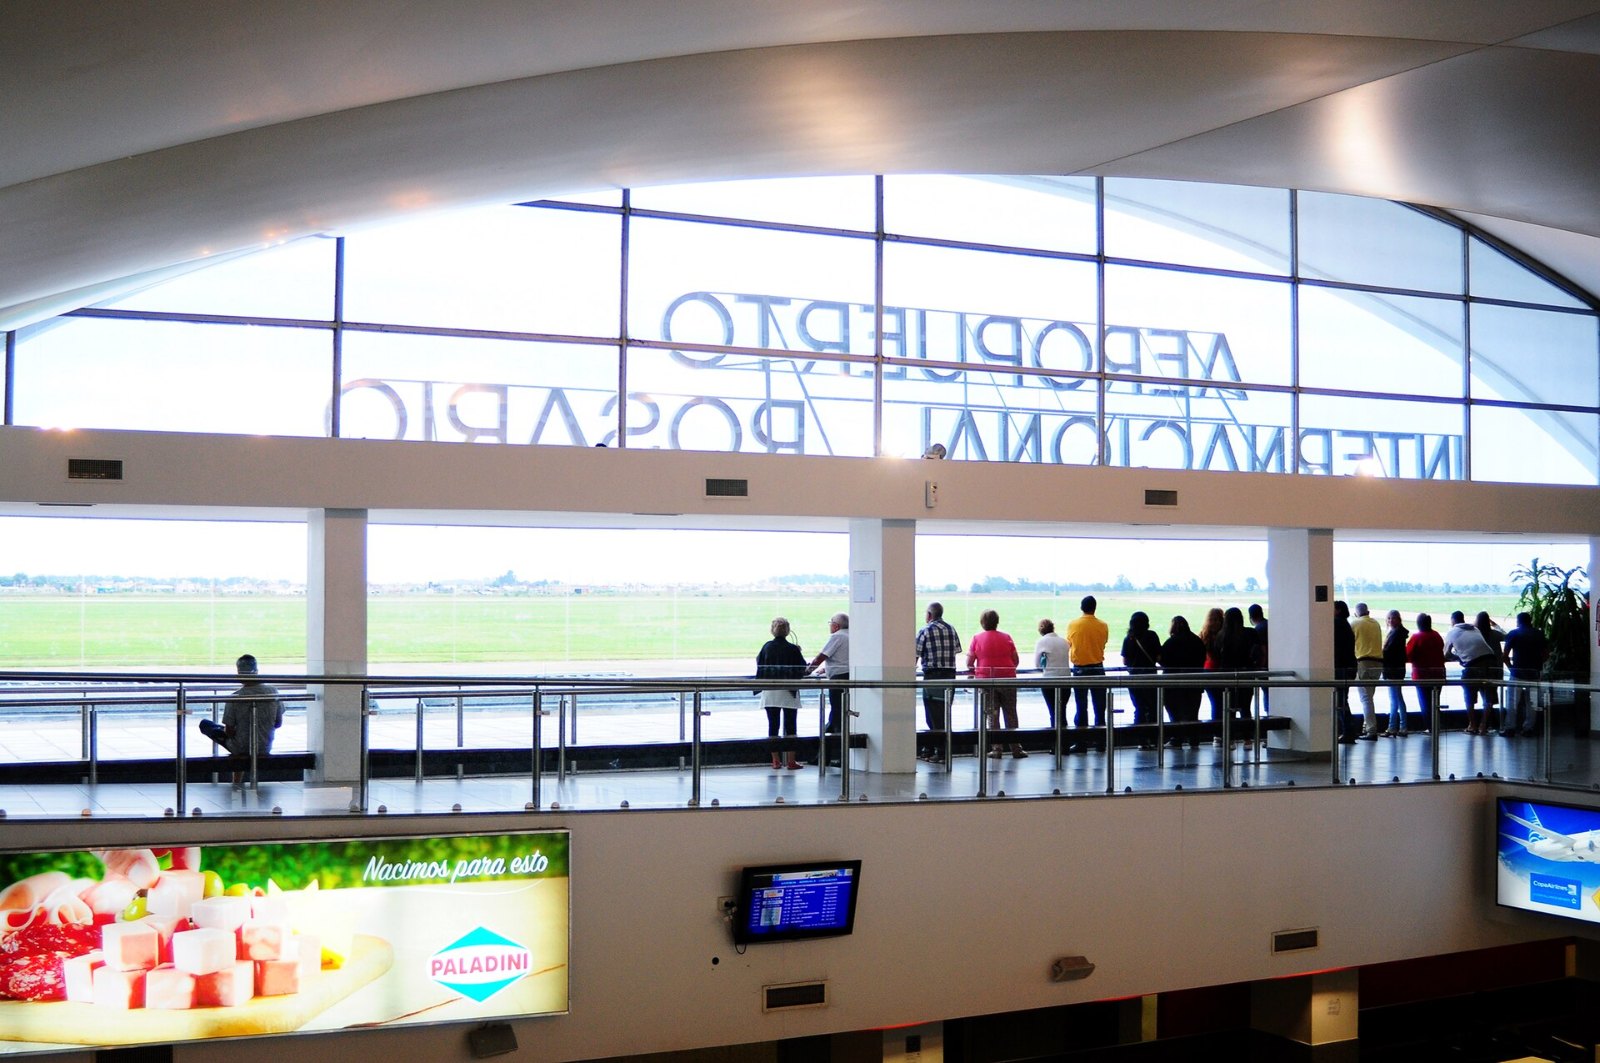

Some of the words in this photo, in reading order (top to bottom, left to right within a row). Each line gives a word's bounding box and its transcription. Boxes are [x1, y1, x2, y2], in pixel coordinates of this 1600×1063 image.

[363, 855, 450, 882] Nacimos
[450, 856, 506, 884] para
[510, 850, 549, 874] esto
[431, 953, 528, 976] PALADINI
